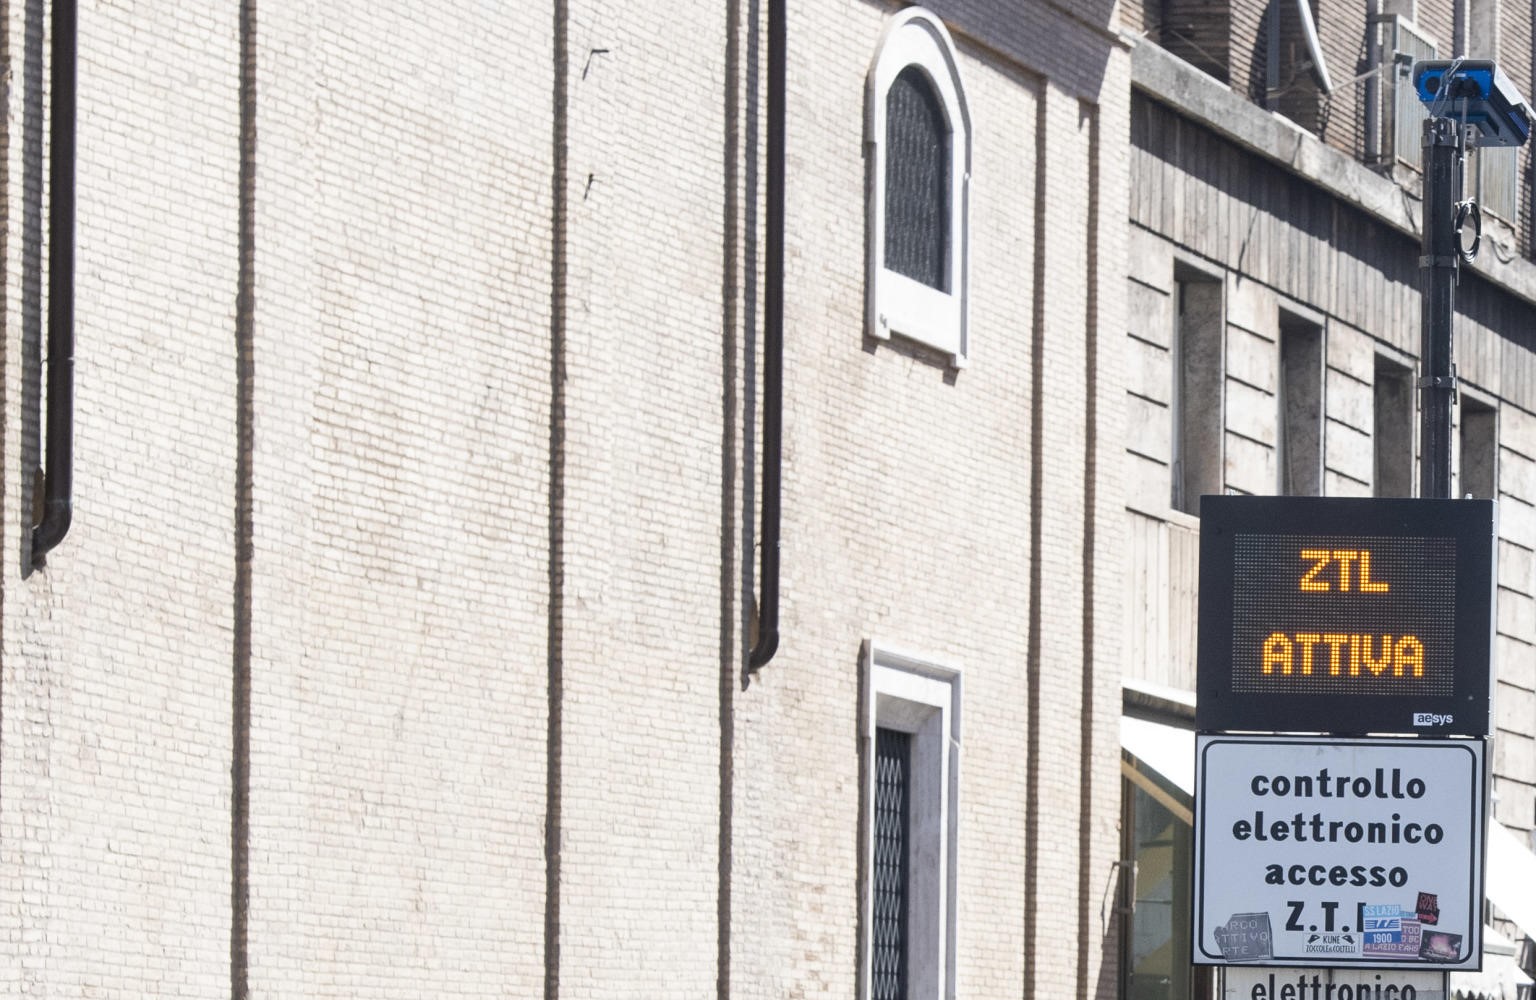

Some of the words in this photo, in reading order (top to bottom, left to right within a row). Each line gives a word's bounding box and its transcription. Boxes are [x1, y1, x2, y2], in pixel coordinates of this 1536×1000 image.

[1300, 549, 1389, 592] ZTL
[1261, 633, 1424, 677] ATTIVA
[1413, 713, 1453, 726] aesys
[1250, 768, 1426, 800] controllo
[1232, 811, 1444, 845] elettronico
[1264, 863, 1409, 889] accesso
[1373, 933, 1392, 943] 1900
